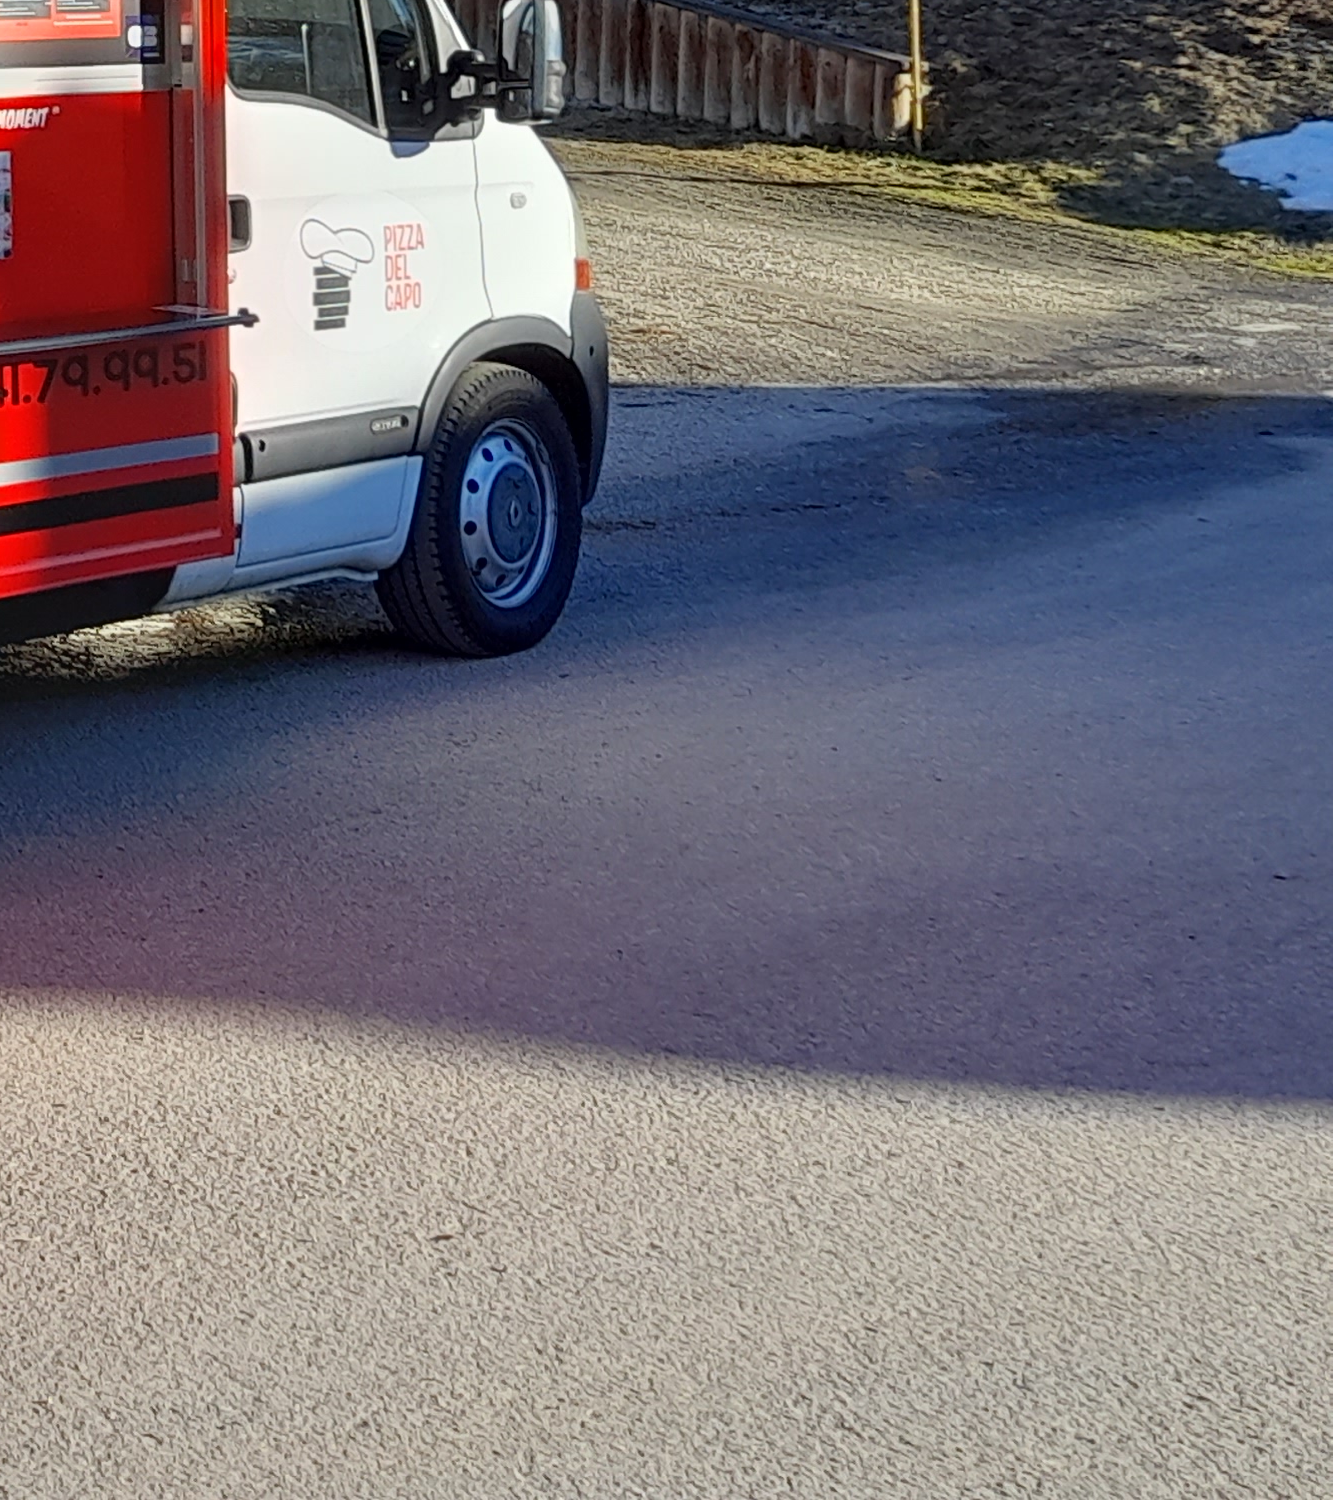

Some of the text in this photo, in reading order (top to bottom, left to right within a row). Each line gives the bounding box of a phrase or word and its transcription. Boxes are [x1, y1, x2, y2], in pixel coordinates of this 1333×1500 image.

[383, 223, 425, 252] PIZZA
[384, 254, 411, 282] DEL
[384, 282, 422, 312] CAPO
